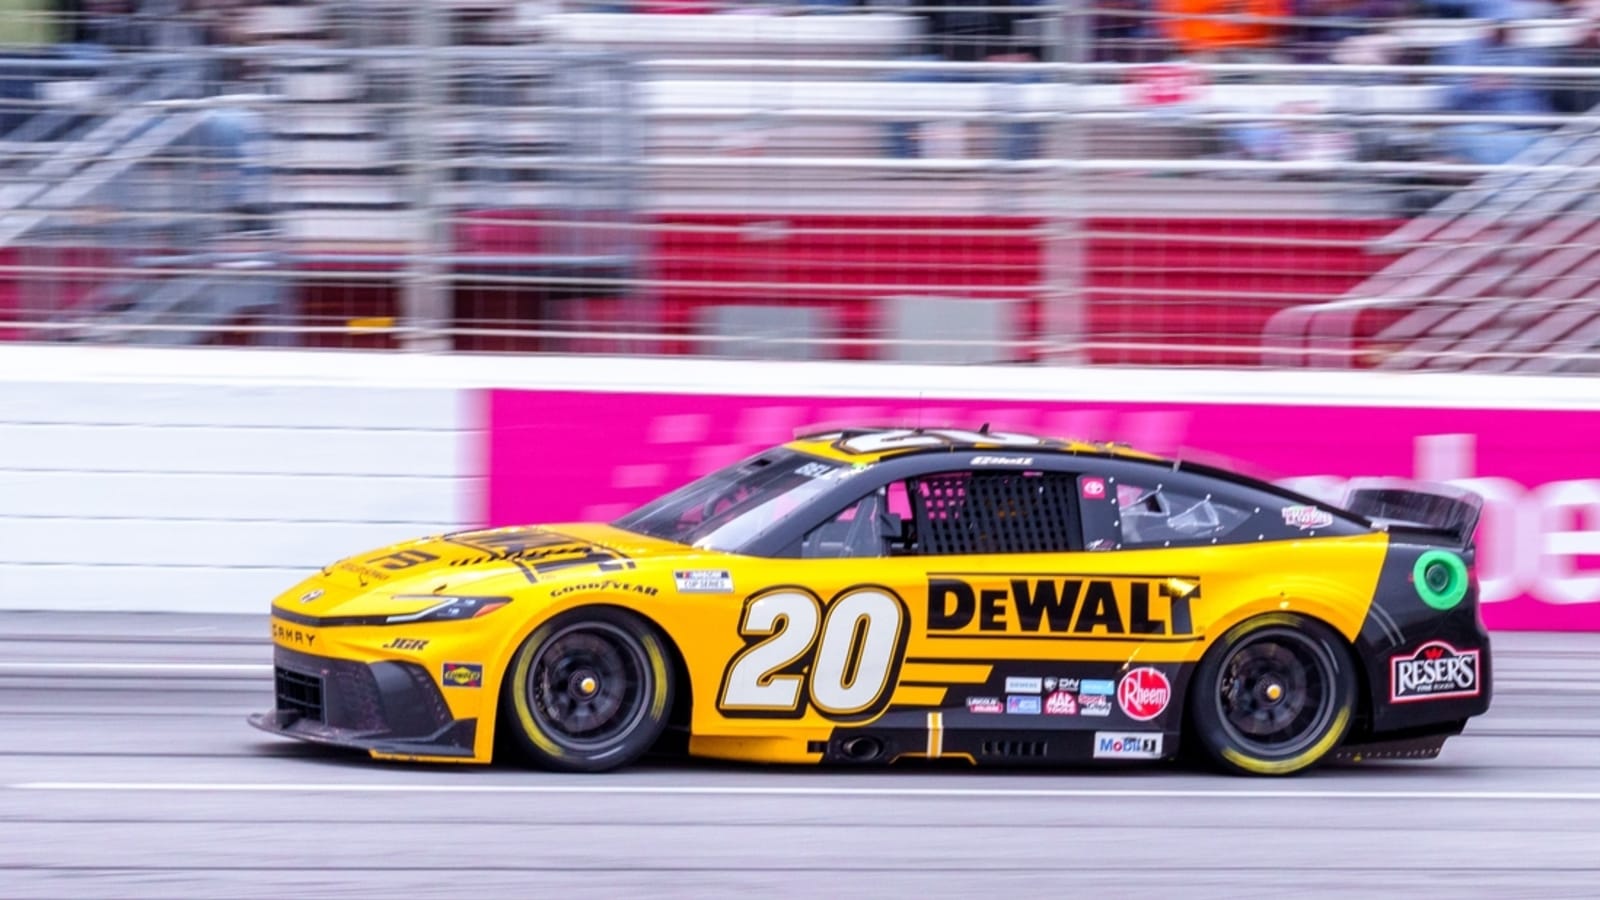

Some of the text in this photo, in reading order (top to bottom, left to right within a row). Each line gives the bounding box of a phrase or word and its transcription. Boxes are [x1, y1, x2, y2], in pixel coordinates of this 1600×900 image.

[550, 580, 658, 597] GOODYEAR
[271, 623, 315, 647] CAMRY
[382, 637, 430, 651] JGR
[718, 584, 910, 722] 20
[1124, 667, 1167, 711] Rheem
[1398, 655, 1474, 695] RESER'S
